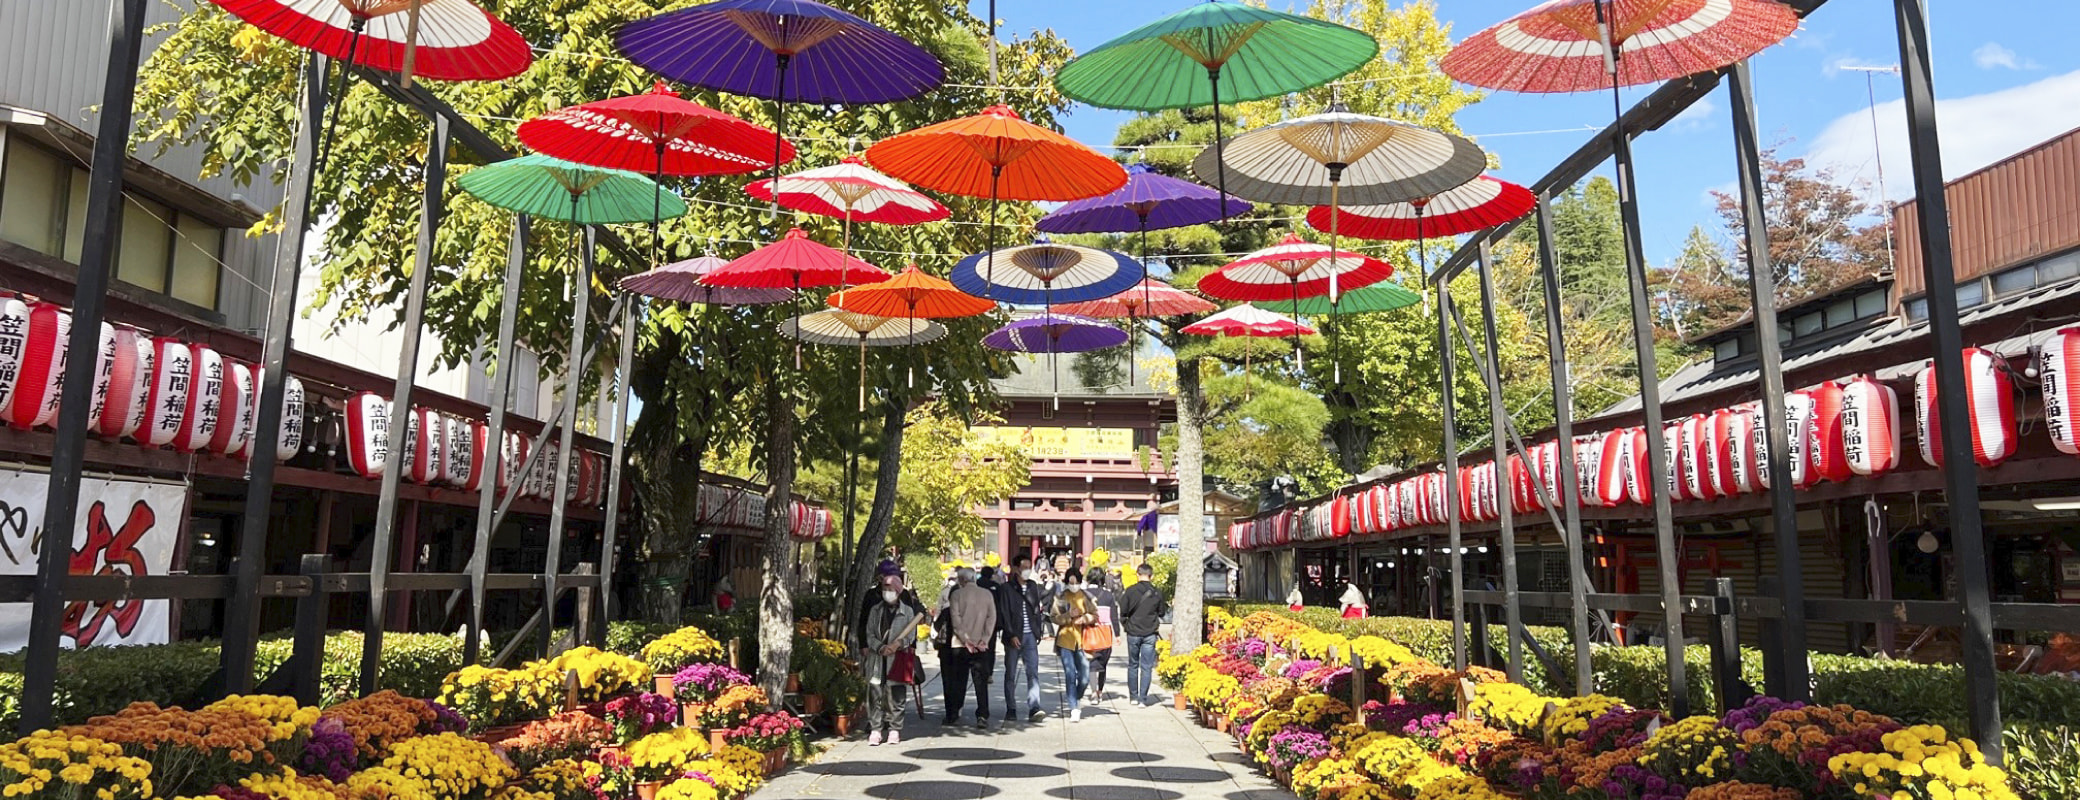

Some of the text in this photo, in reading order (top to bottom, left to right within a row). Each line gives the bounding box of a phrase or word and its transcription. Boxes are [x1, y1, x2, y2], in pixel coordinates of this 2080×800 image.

[160, 357, 190, 432] 笠間稲荷
[198, 362, 223, 436] 笠間稲荷
[282, 389, 303, 449] 笠間稲荷
[369, 404, 388, 462] 笠間稲荷
[457, 430, 472, 479] 笠間稲荷
[1842, 394, 1862, 463] 笠間稲荷
